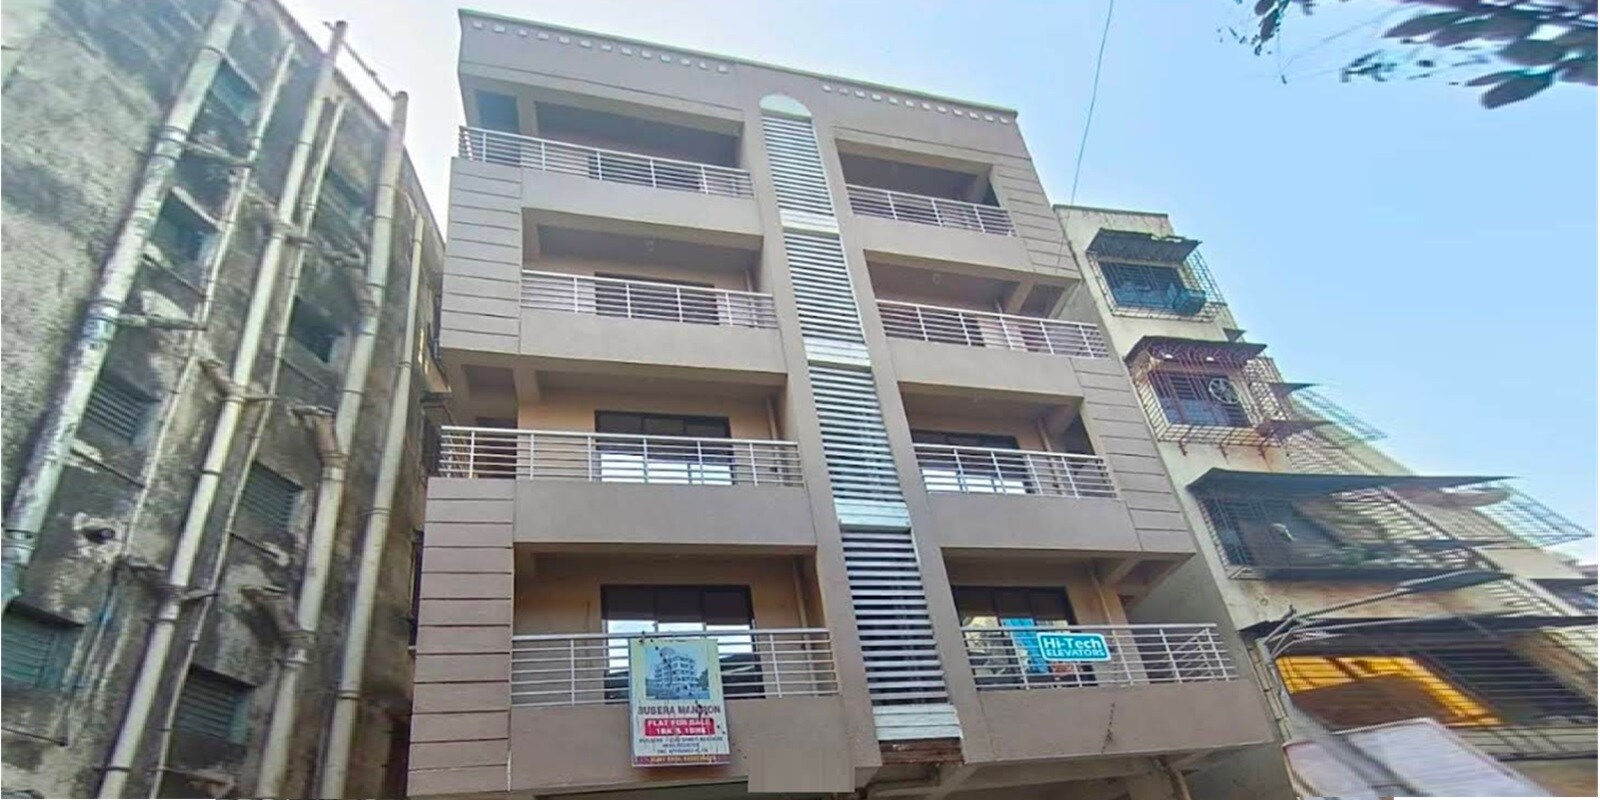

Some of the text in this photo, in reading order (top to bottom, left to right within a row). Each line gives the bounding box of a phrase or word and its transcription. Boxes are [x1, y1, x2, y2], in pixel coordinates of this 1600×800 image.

[1043, 637, 1102, 649] Hi-Tech
[1046, 649, 1106, 657] ELEVATORS
[647, 719, 668, 727] FLAT
[688, 718, 711, 726] SALE
